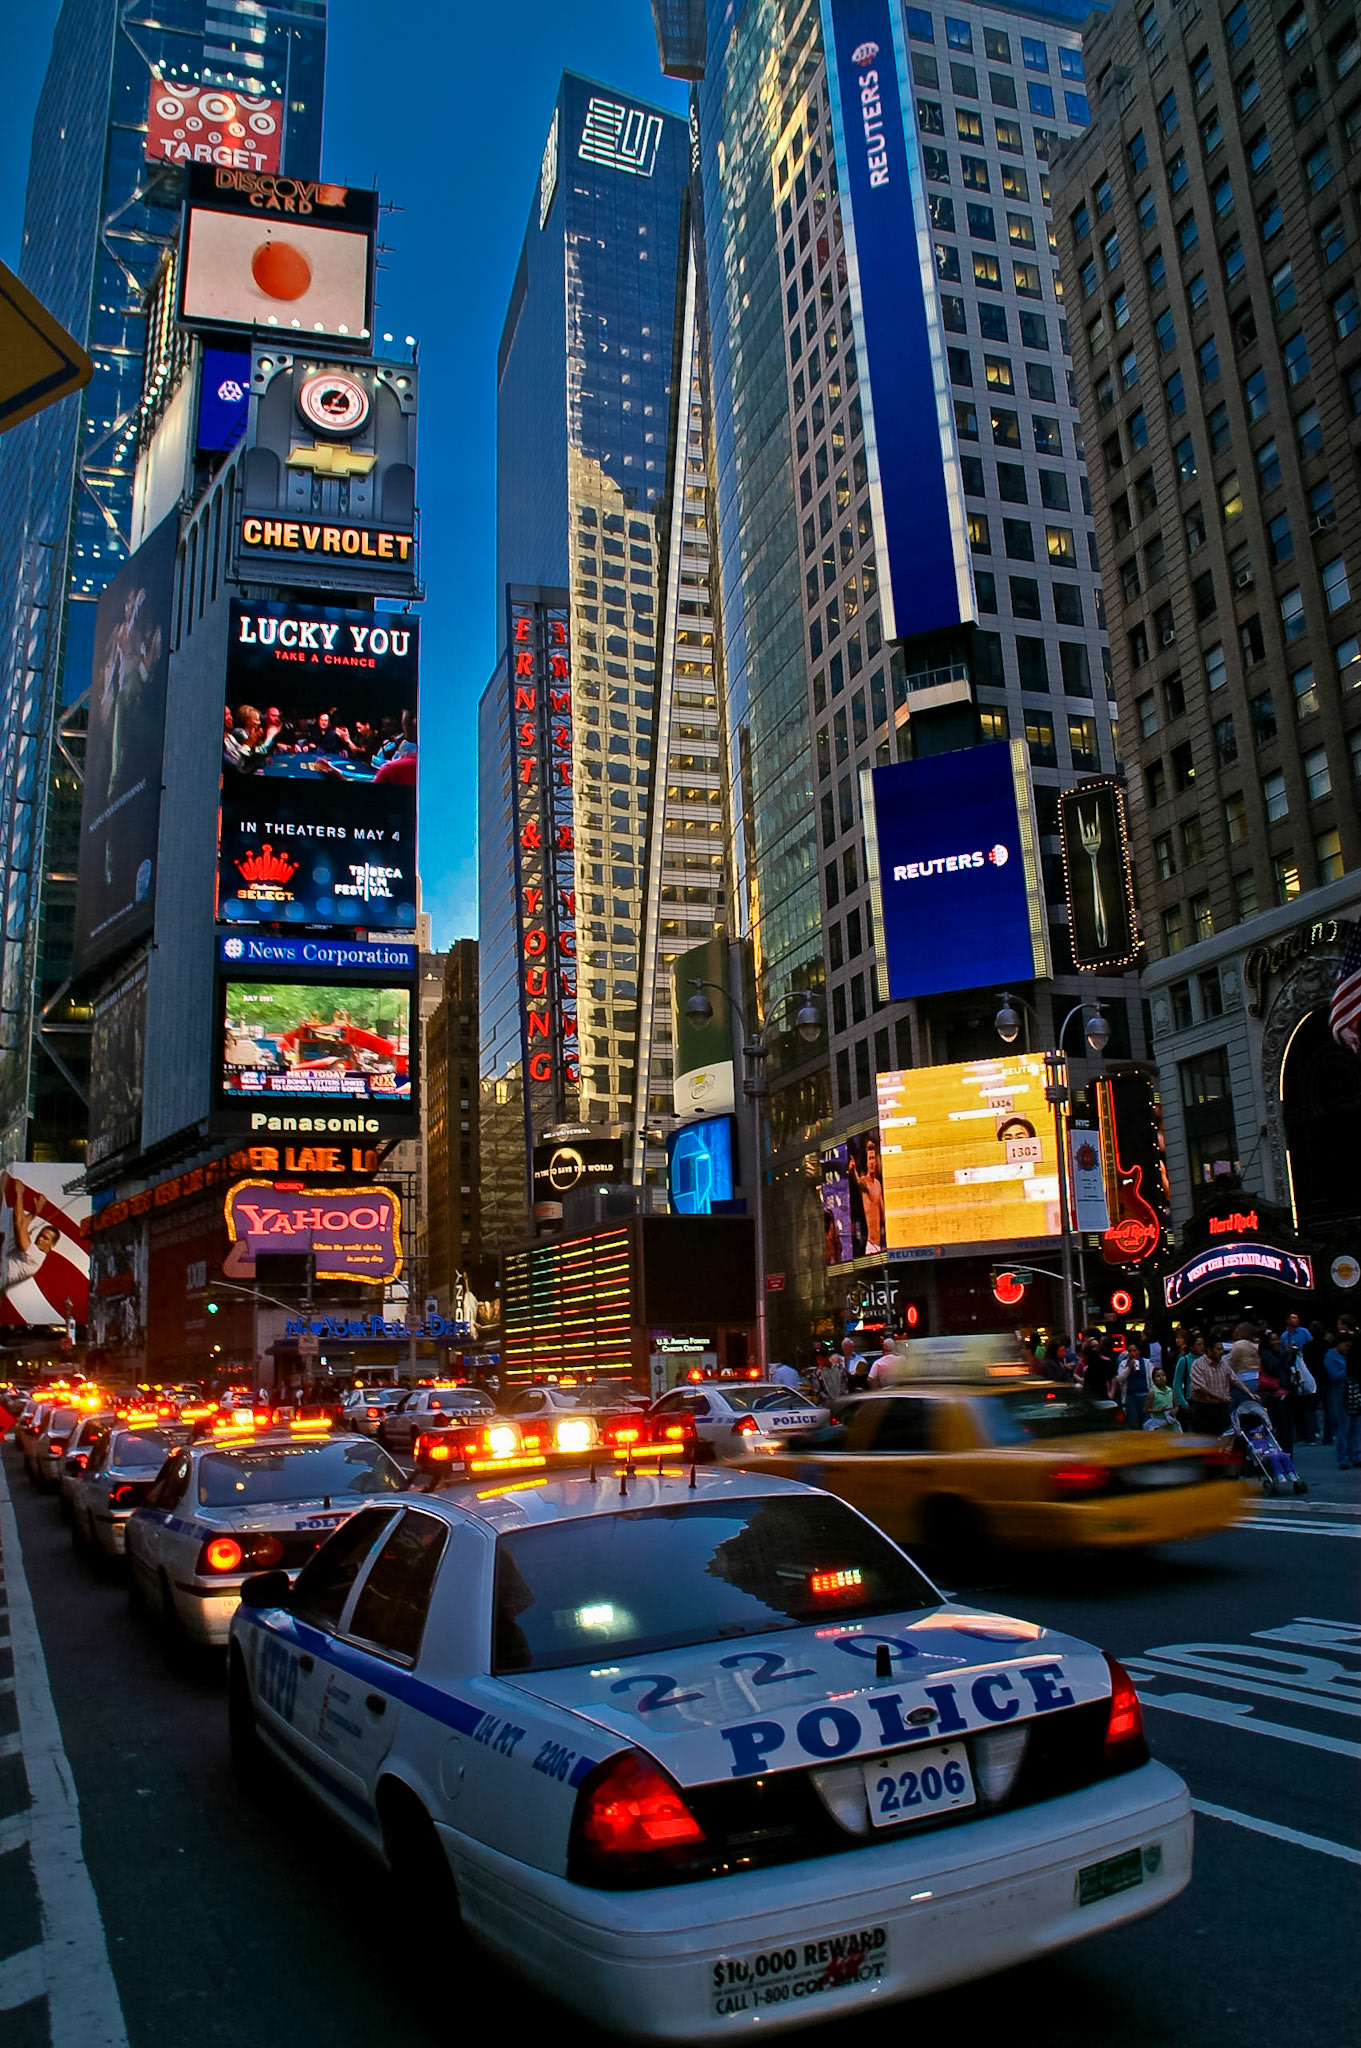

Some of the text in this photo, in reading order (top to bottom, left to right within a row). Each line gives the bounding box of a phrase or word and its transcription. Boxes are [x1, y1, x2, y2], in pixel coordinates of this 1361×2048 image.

[858, 70, 890, 189] REUTERS
[160, 138, 268, 171] TARGET
[215, 168, 349, 207] DISCOVER
[250, 193, 313, 214] CARD
[243, 519, 412, 559] CHEVROLET
[239, 616, 411, 657] LUCKY YOU
[274, 650, 376, 668] TAKE A CHANCE
[240, 821, 400, 842] IN THEATERS MAY 4
[514, 618, 552, 1083] ERNST & YOUNG
[349, 864, 403, 880] TRIBECA
[893, 850, 985, 881] REUTERS
[334, 884, 394, 898] FESTIVAL
[248, 941, 410, 967] News Corporation
[286, 1070, 347, 1079] NEW TODAY
[370, 1073, 397, 1087] FOX
[1001, 1062, 1046, 1077] REUTS
[251, 1113, 380, 1132] Panasonic
[1011, 1146, 1038, 1159] 1302
[558, 1166, 572, 1175] SAVE
[587, 1164, 614, 1172] WORLD
[236, 1203, 390, 1235] YAHOO!
[1208, 1210, 1259, 1235] Hard Rock
[1017, 1238, 1066, 1249] REUTER
[1104, 1224, 1156, 1240] Hard Rock
[889, 1248, 934, 1260] REUTERS
[1187, 1252, 1283, 1283] VISIT THE RESTAURANT
[773, 1415, 817, 1426] POLICE
[720, 1663, 1077, 1777] POLICE
[493, 1722, 527, 1758] PCT
[532, 1739, 577, 1783] 2206
[877, 1761, 966, 1813] 2206
[714, 1927, 887, 1988] $10,000 REWARD
[716, 1993, 749, 2015] CALL
[754, 1984, 790, 2007] 1-800
